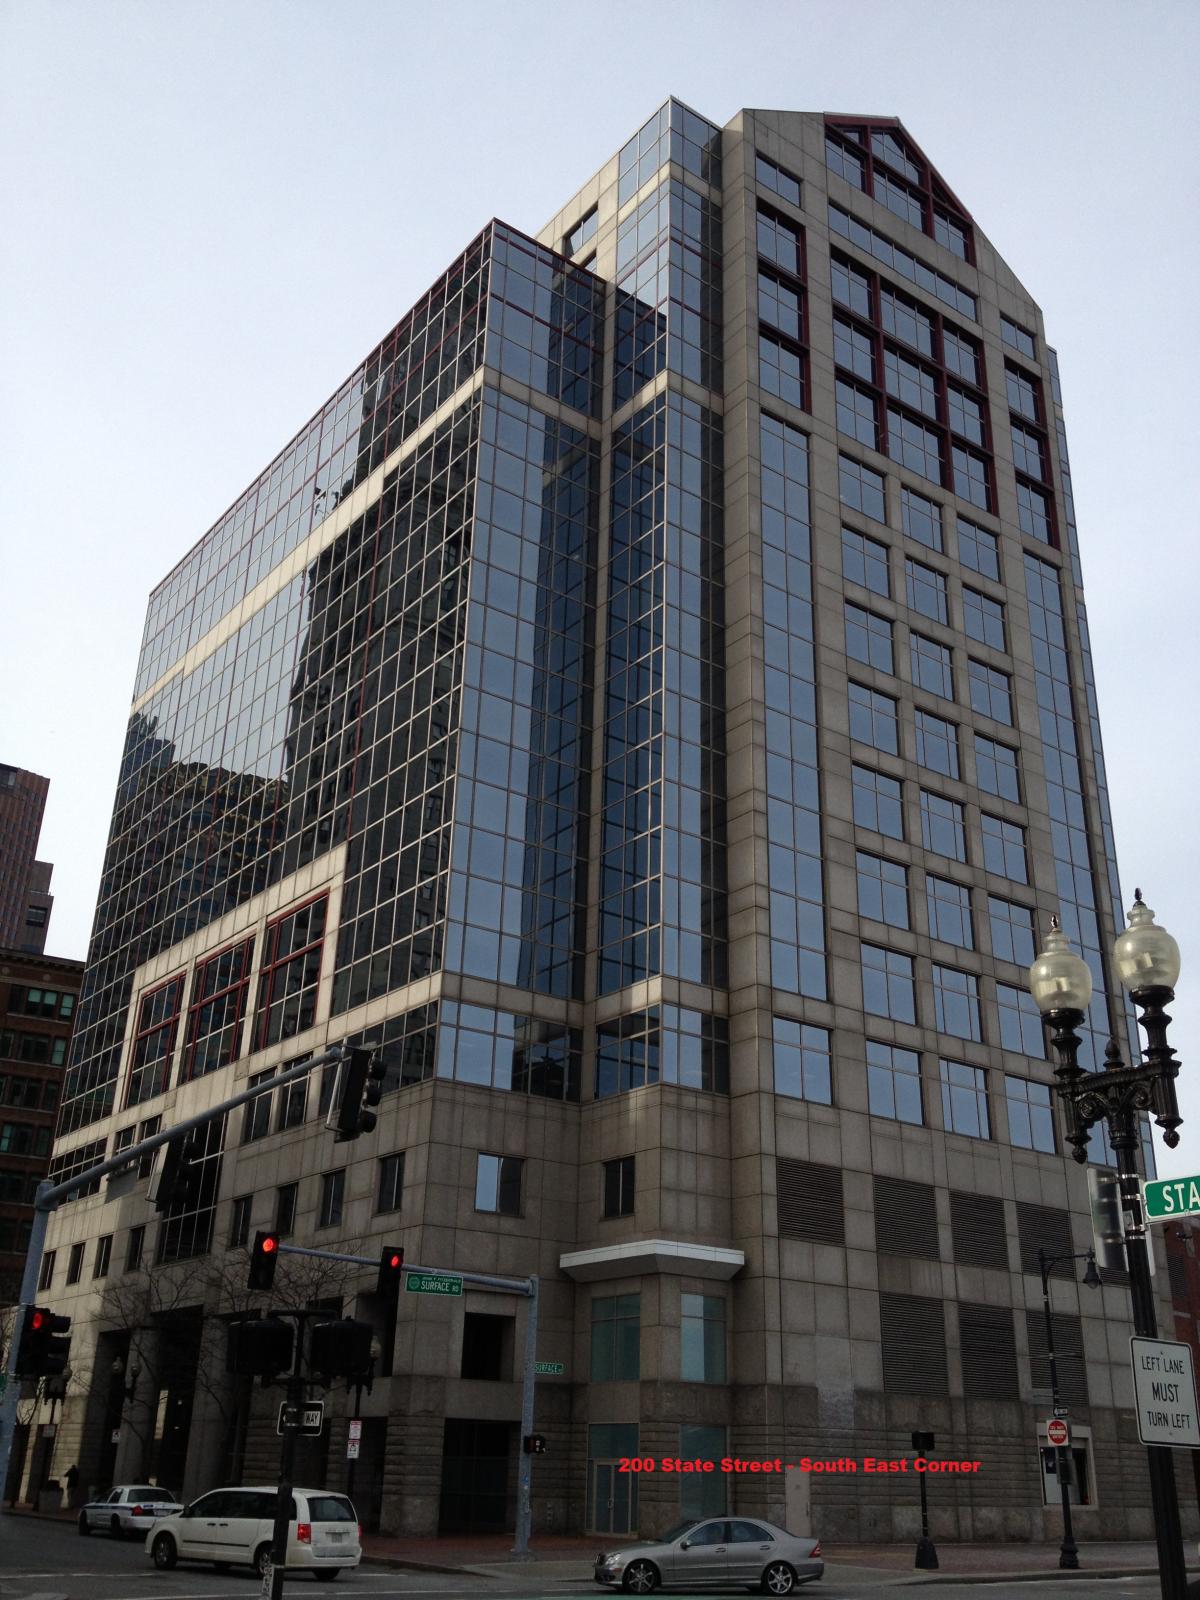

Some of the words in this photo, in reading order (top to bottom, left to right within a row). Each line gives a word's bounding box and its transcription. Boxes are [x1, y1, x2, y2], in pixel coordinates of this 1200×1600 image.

[421, 1280, 450, 1292] SURFACE
[1142, 1355, 1161, 1371] LEFT
[1163, 1358, 1185, 1375] LANE
[1151, 1381, 1179, 1403] MUST
[1147, 1410, 1169, 1427] TURN
[1171, 1413, 1190, 1429] LEFT
